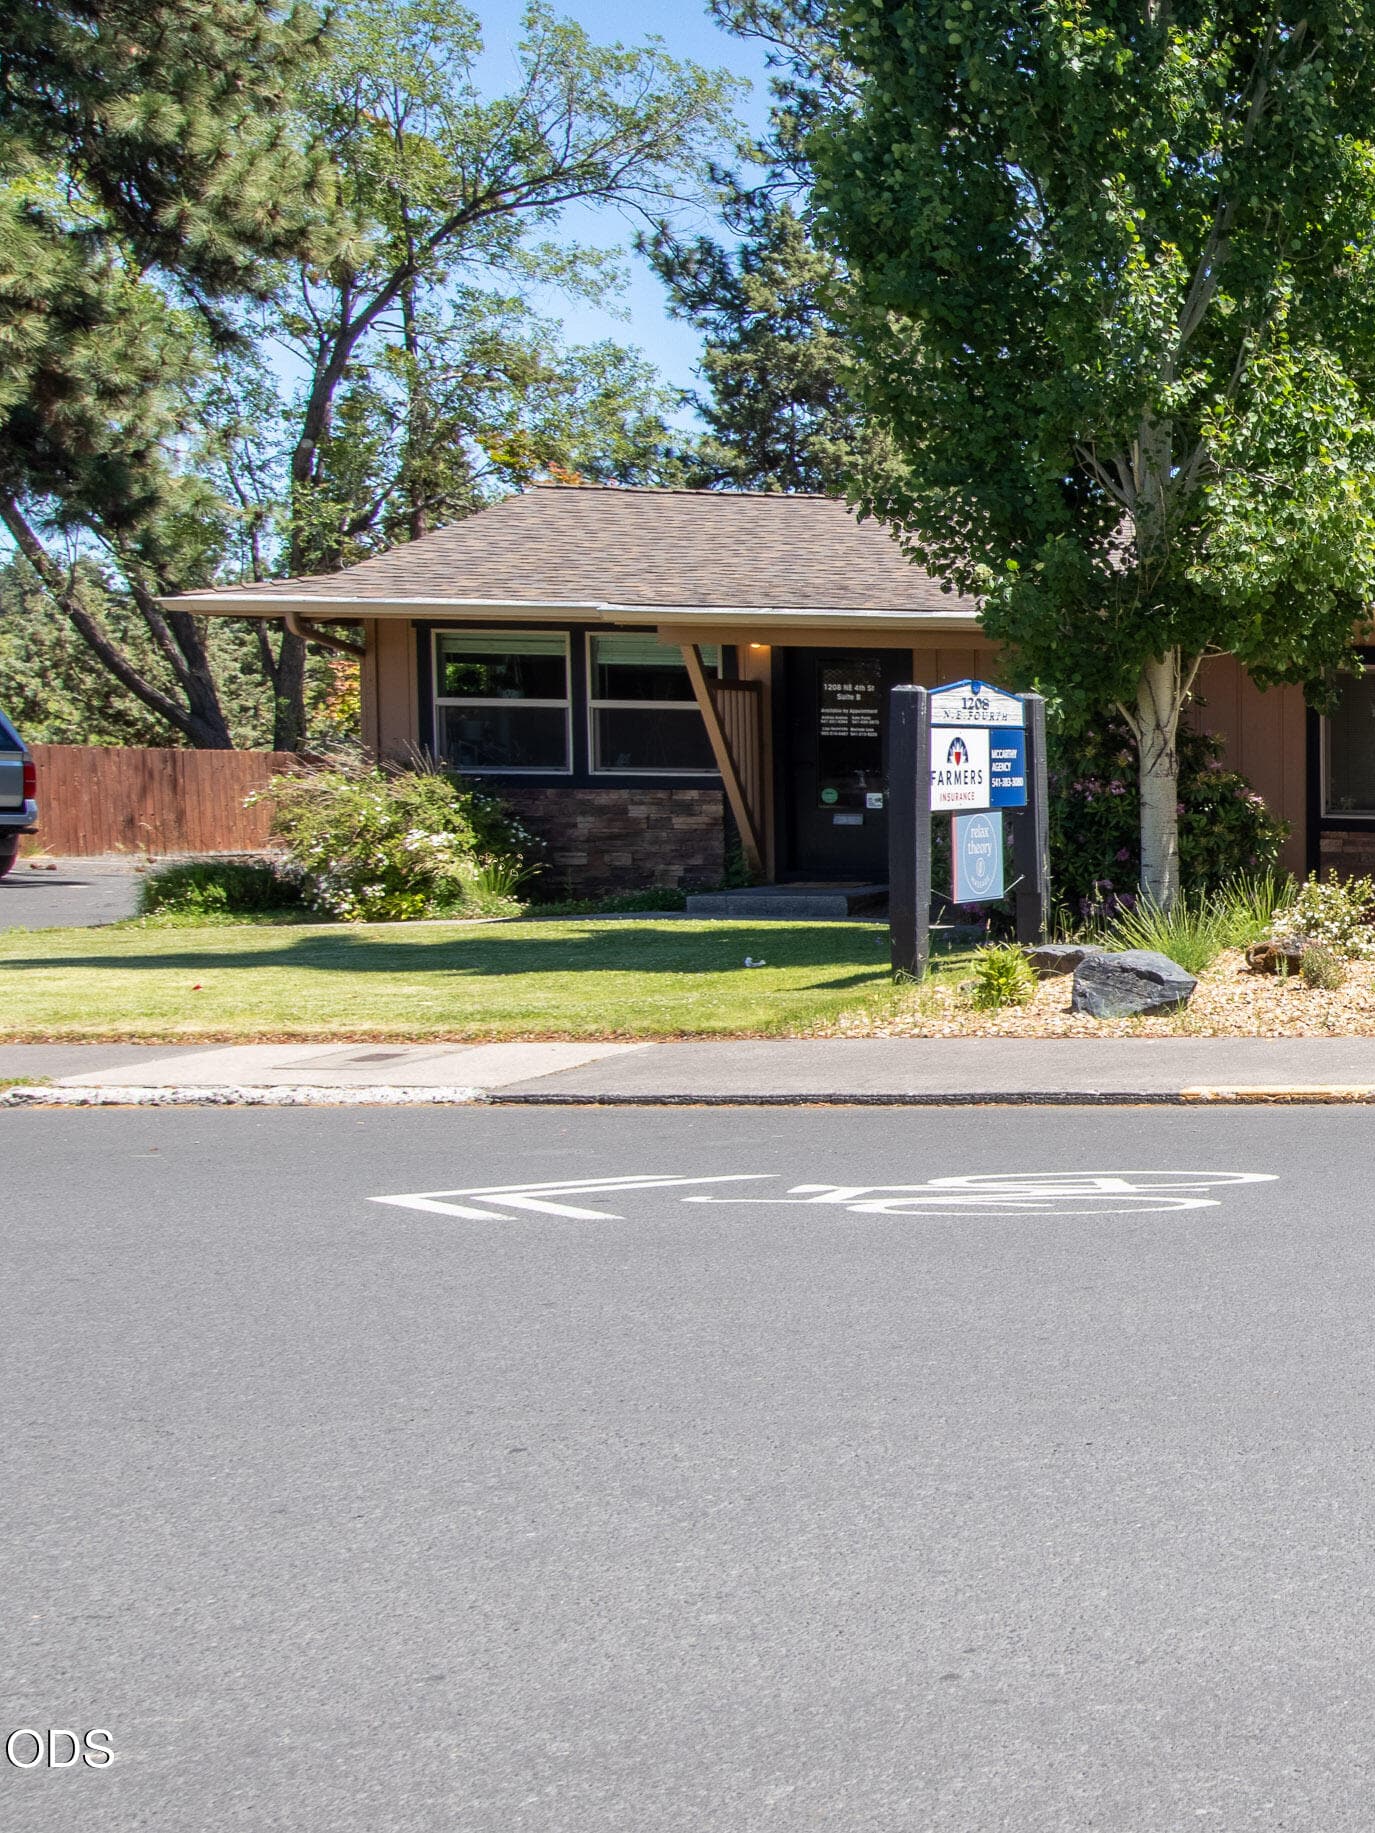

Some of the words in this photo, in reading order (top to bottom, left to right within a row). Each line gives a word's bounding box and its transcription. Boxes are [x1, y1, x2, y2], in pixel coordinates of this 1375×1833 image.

[824, 683, 841, 691] 1208
[961, 697, 990, 711] 1208
[991, 762, 1011, 772] AGENCY
[931, 769, 983, 786] FARMERS
[940, 791, 975, 802] INSURANCE
[971, 823, 990, 838] relax
[968, 840, 992, 857] theory
